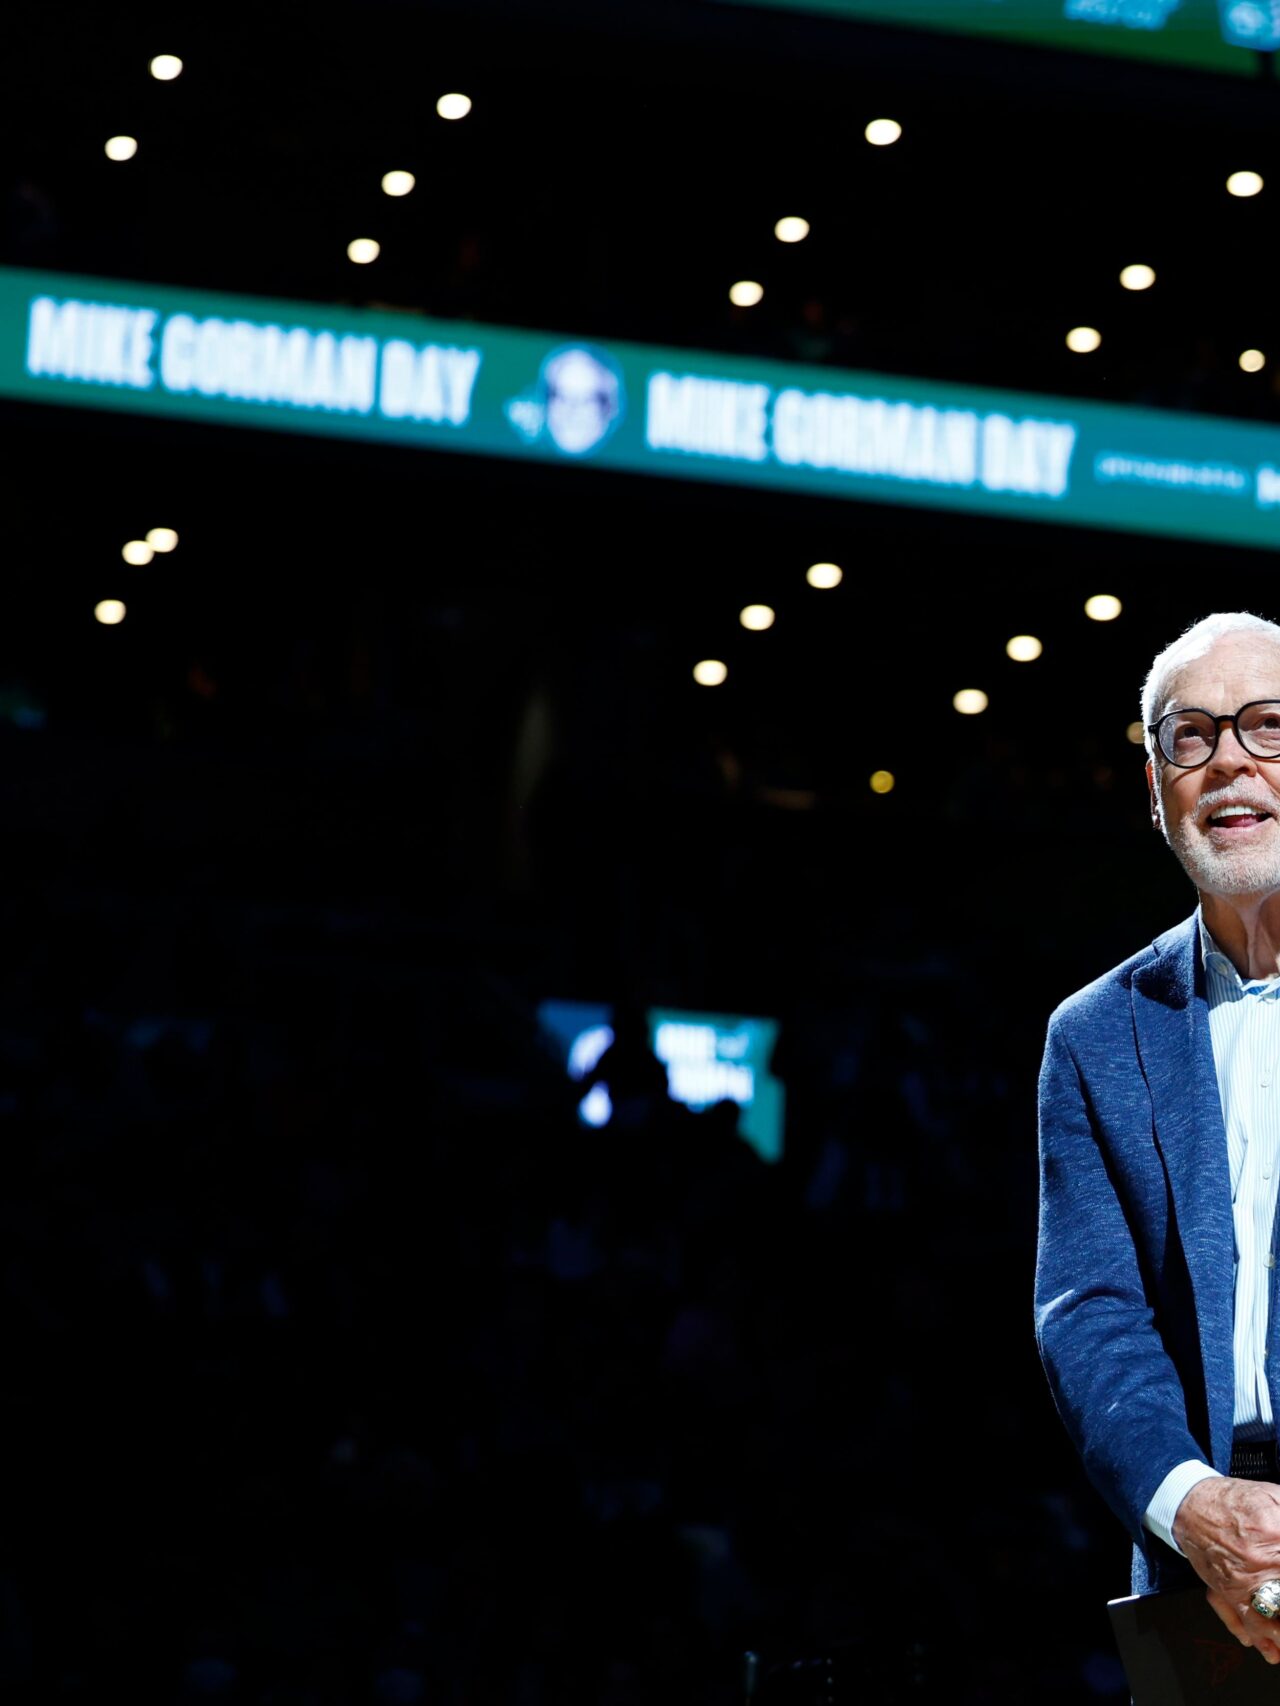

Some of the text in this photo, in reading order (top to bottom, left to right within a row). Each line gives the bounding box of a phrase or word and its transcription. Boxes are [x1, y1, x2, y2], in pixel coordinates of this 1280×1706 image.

[27, 298, 156, 388] MIKE
[380, 340, 479, 424] DAY
[647, 373, 769, 461] MIKE
[980, 414, 1075, 496] DAY
